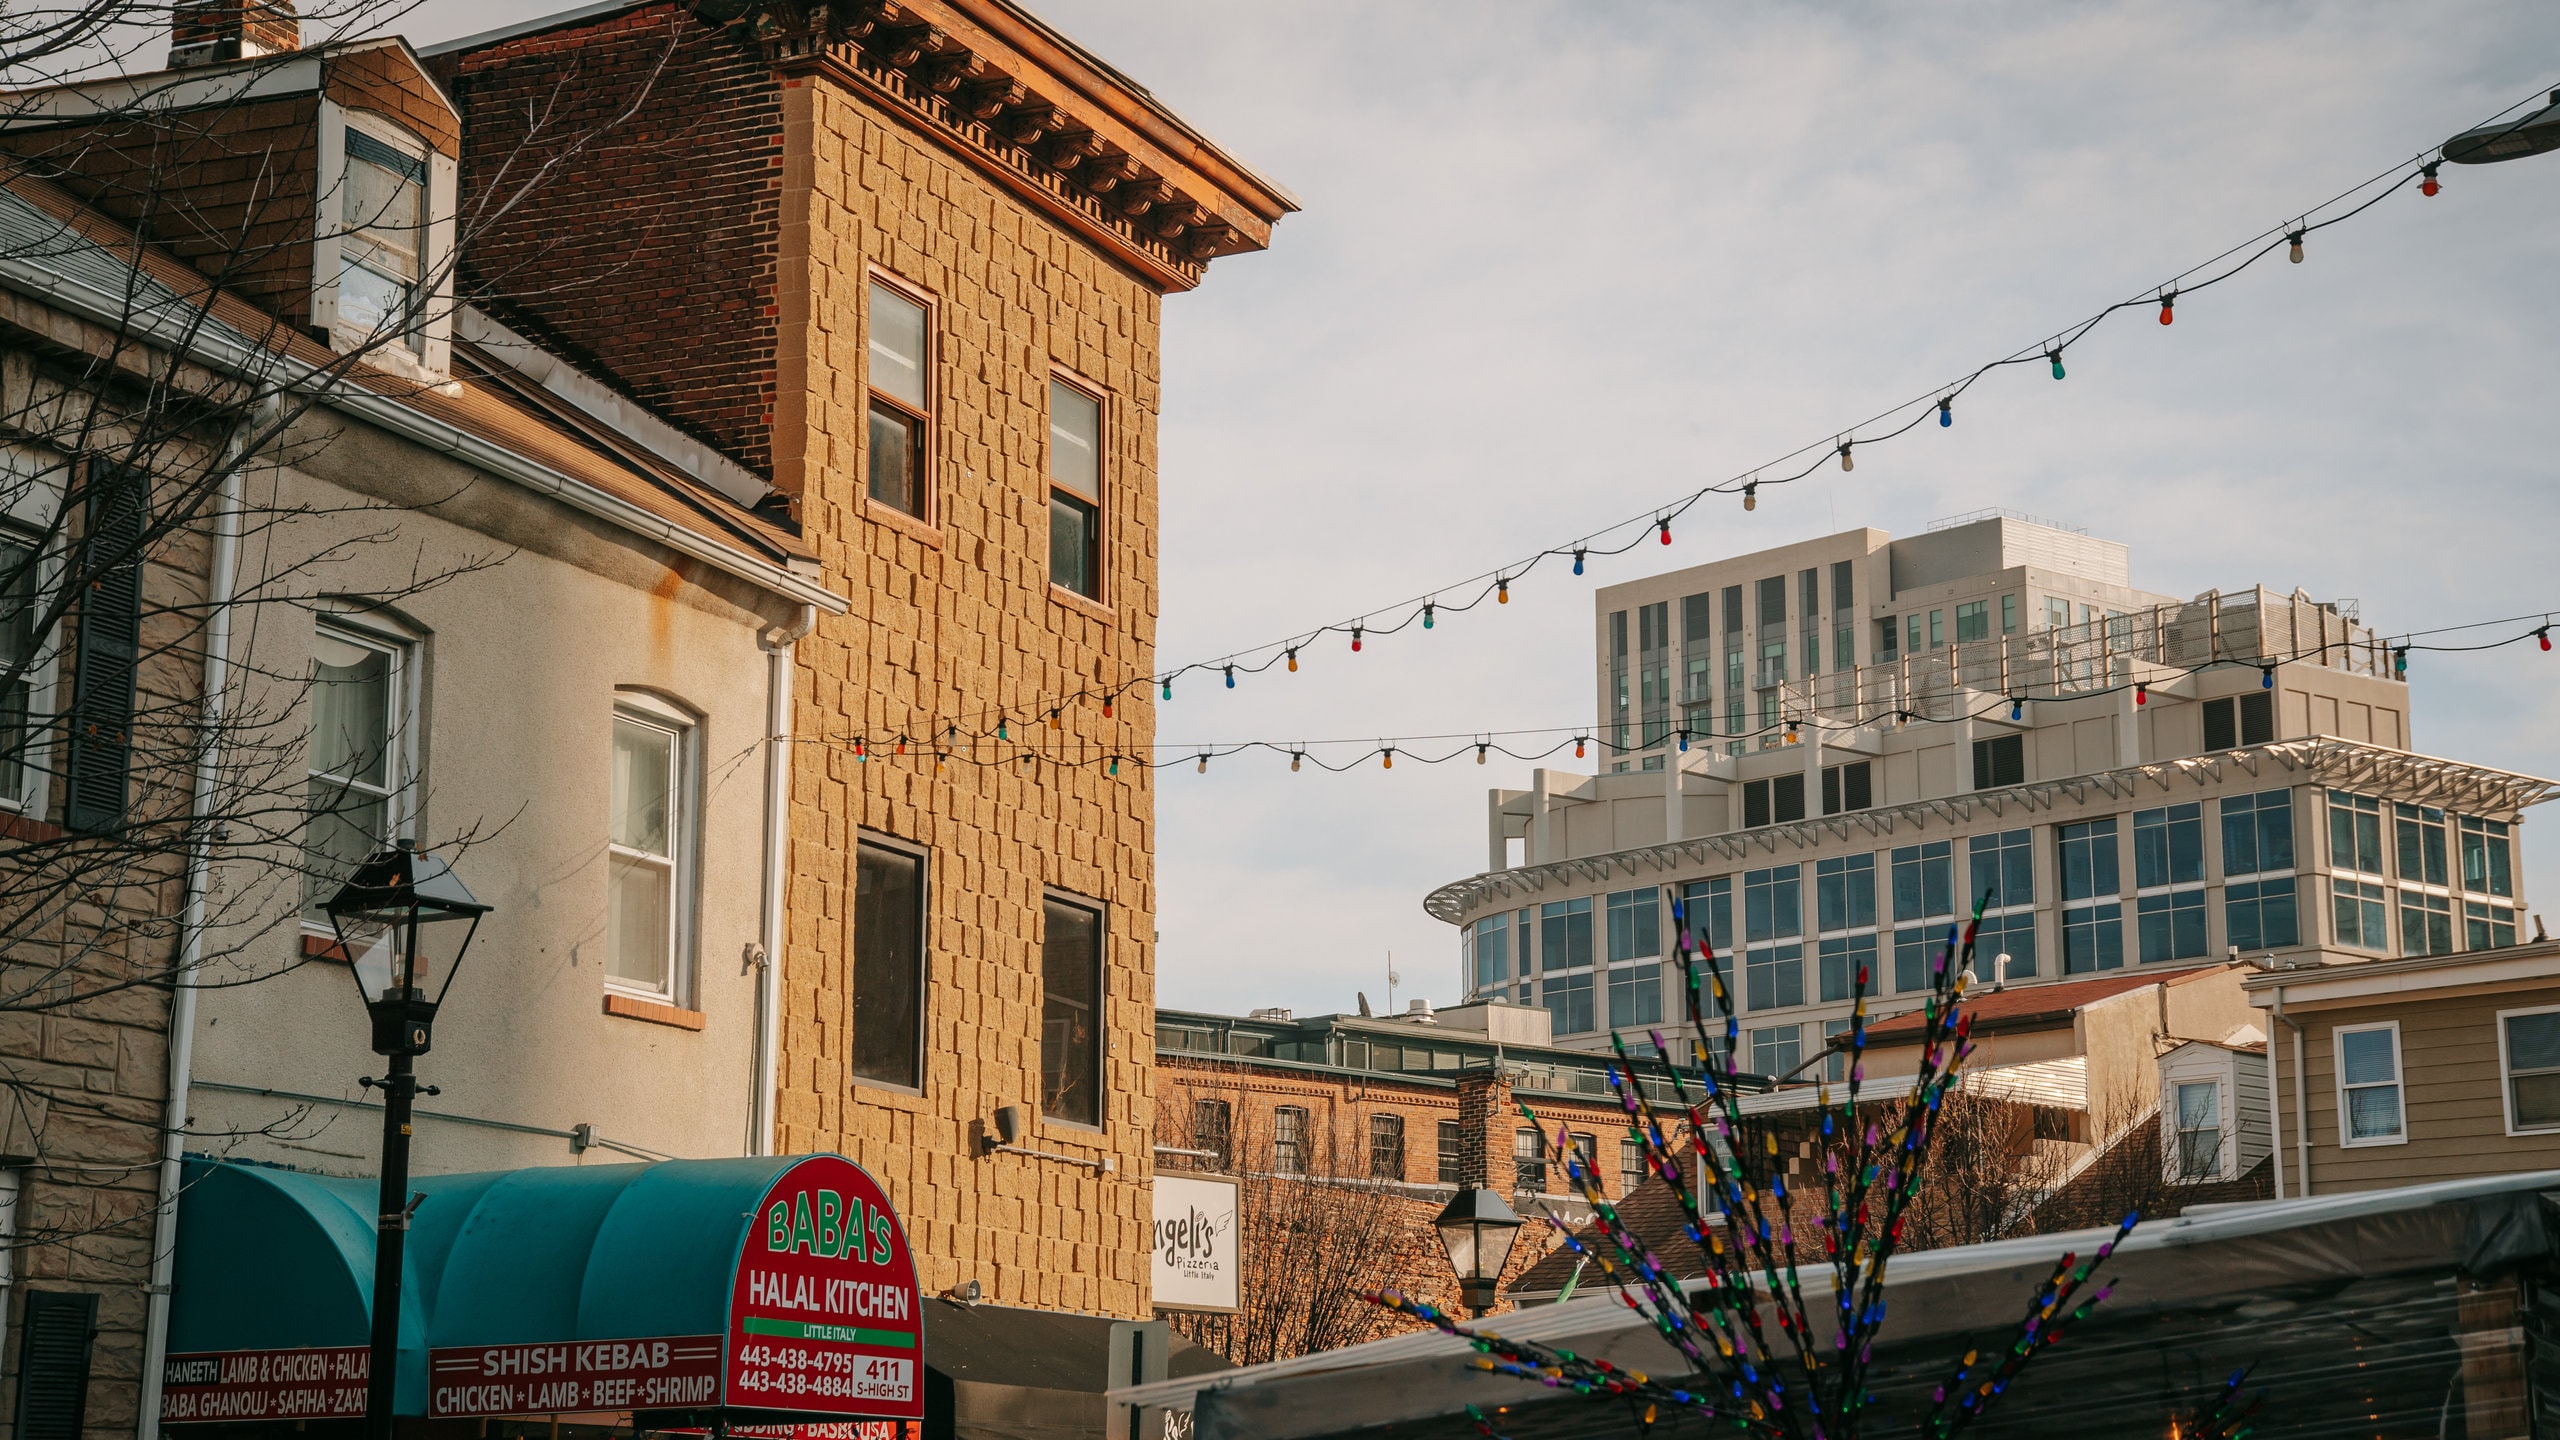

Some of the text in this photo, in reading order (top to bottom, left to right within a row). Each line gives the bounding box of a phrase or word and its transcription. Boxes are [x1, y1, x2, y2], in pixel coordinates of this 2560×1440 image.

[768, 1189, 893, 1266] BABA'S
[1177, 1256, 1219, 1271] Pizzeria
[1184, 1271, 1215, 1281] Little Italy
[750, 1269, 909, 1321] HALAL KITCHEN
[804, 1324, 857, 1342] LITTLE ITALY
[165, 1361, 218, 1383] HANEETH
[220, 1355, 258, 1384] LAMB
[259, 1356, 270, 1383] &
[272, 1354, 328, 1382] CHICKEN
[483, 1342, 670, 1377] SHISH KEBAB
[739, 1344, 851, 1374] 443-438-4795
[866, 1359, 900, 1381] 411
[436, 1375, 716, 1414] CHICKEN LAMB BEEF SHRIMP
[738, 1369, 851, 1398] 443-438-4884
[857, 1382, 909, 1398] S-HIGH ST
[160, 1393, 197, 1418] BABA
[201, 1391, 269, 1416] GHANOUJ
[278, 1389, 326, 1414] SAFIHA
